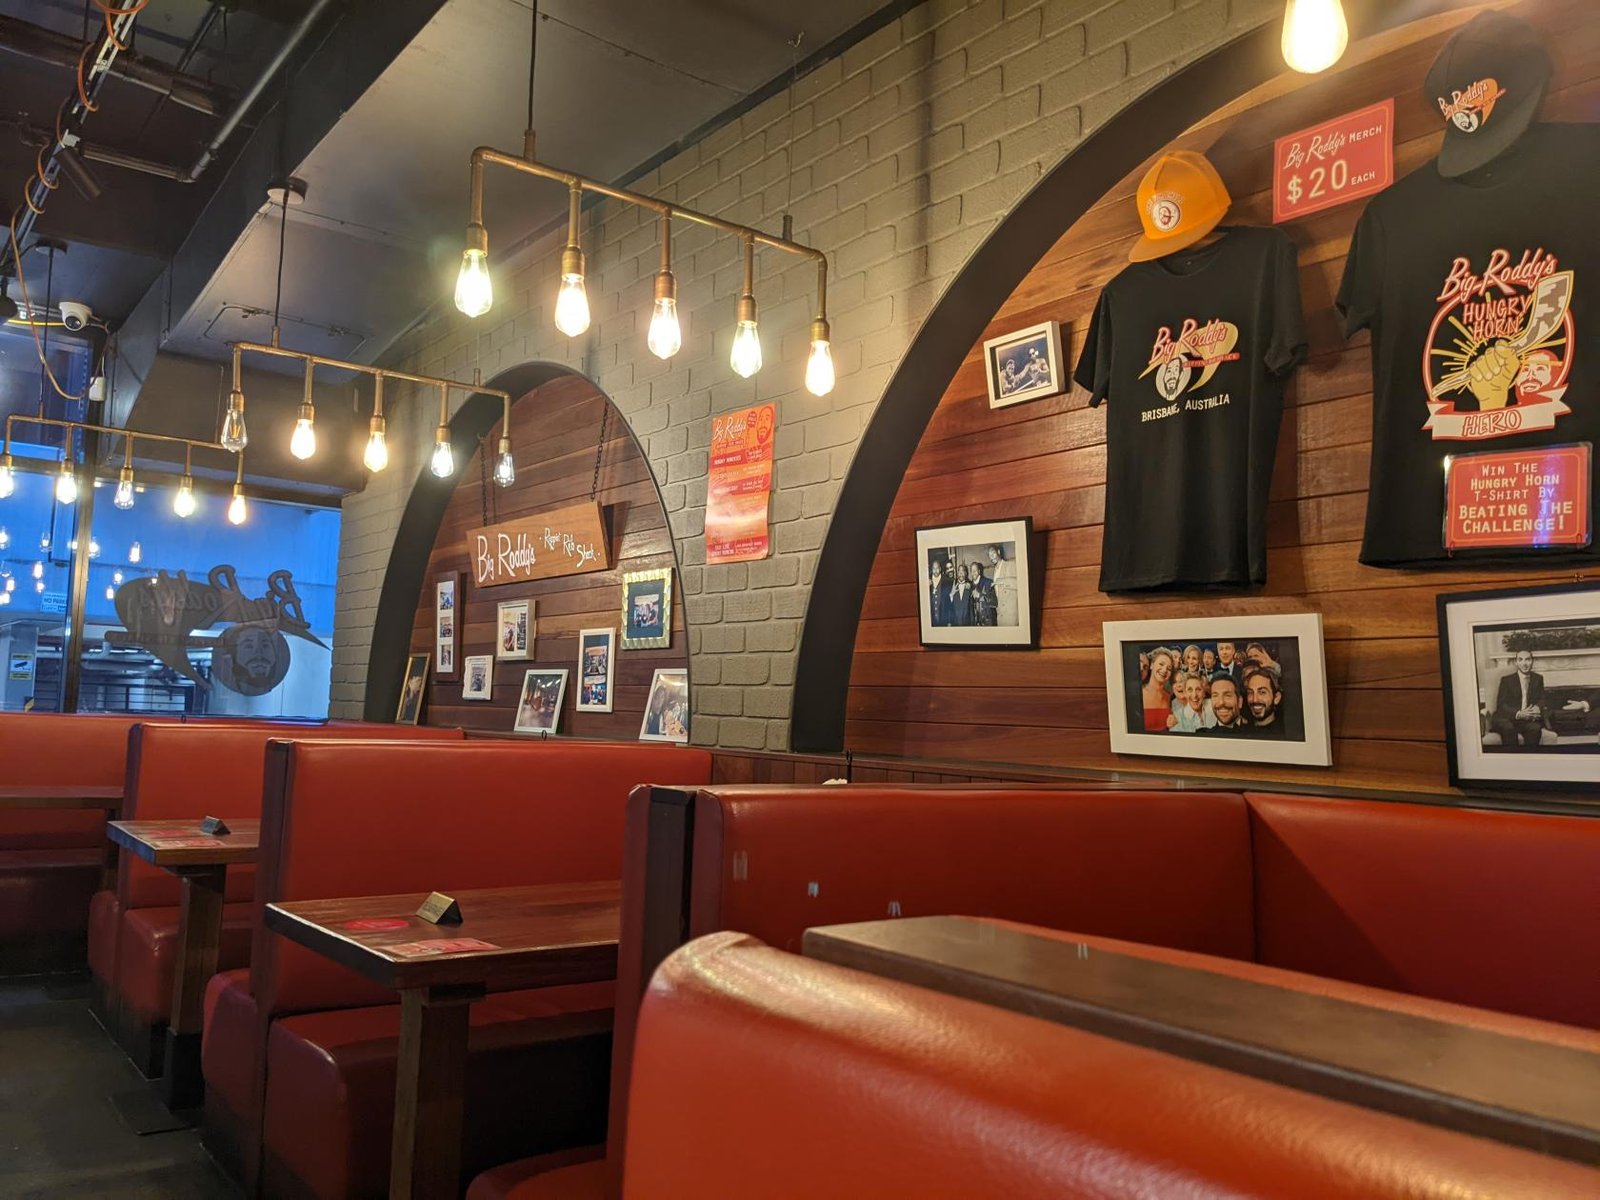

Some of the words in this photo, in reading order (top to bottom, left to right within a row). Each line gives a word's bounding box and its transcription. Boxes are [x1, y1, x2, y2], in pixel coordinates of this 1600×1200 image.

[1283, 142, 1304, 170] Big
[1305, 131, 1345, 163] Roddy's
[1349, 125, 1382, 143] MERCH
[1351, 171, 1375, 185] EACH
[1436, 256, 1477, 302] Big
[1479, 247, 1558, 297] Roddy's
[1463, 294, 1534, 324] HUNGRY
[1148, 326, 1176, 365] Big
[1179, 318, 1228, 357] Roddy's
[1472, 315, 1521, 342] HORN
[1461, 410, 1522, 436] HERO
[1470, 477, 1517, 491] HUNGRY
[1525, 474, 1560, 486] HORN
[1482, 464, 1505, 477] WIN
[1514, 462, 1538, 474] THE
[1474, 489, 1529, 502] T-SHIRT
[1538, 486, 1555, 498] BY
[1459, 503, 1528, 520] BEATING
[1540, 500, 1573, 515] THE
[477, 535, 495, 583] Big
[497, 532, 536, 577] Roddy's
